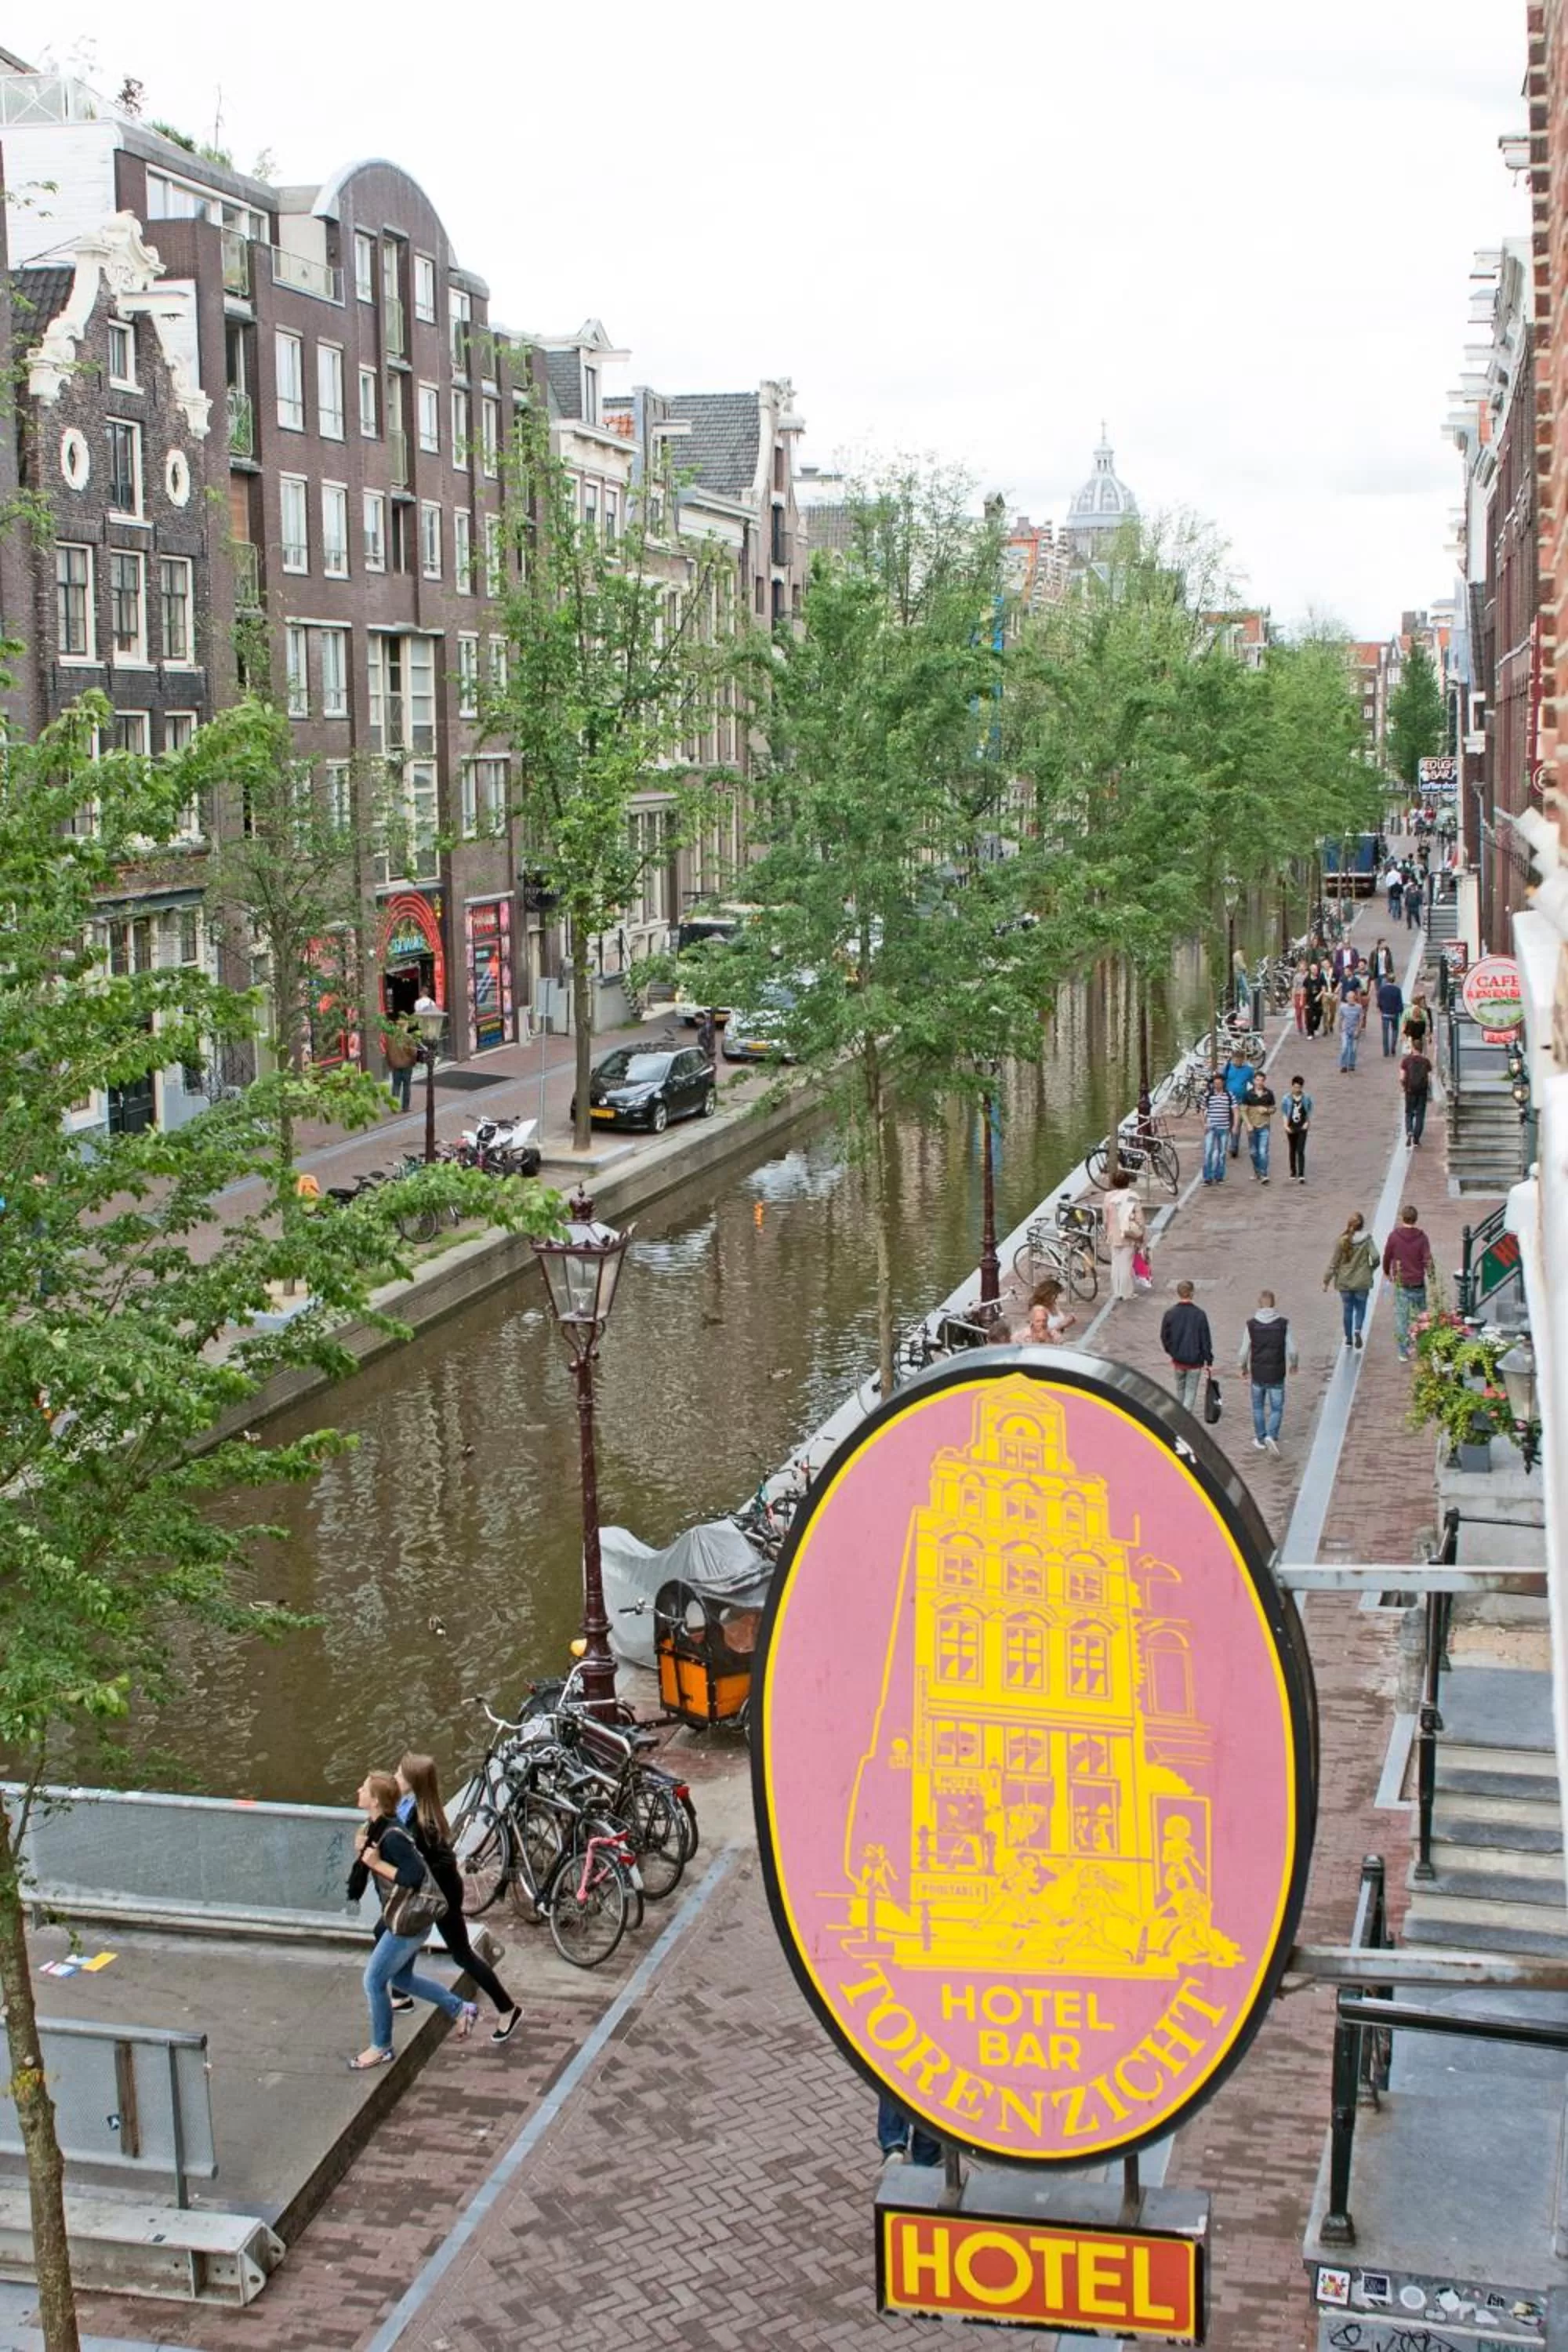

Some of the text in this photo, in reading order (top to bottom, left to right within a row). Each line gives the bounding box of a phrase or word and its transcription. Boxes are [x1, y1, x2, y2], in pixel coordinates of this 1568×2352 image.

[1476, 975, 1519, 987] CAFE
[941, 1984, 1116, 2031] HOTEL
[840, 1962, 1227, 2138] TORENZICHT
[978, 2031, 1081, 2071] BAR
[901, 2223, 1176, 2321] HOTEL
